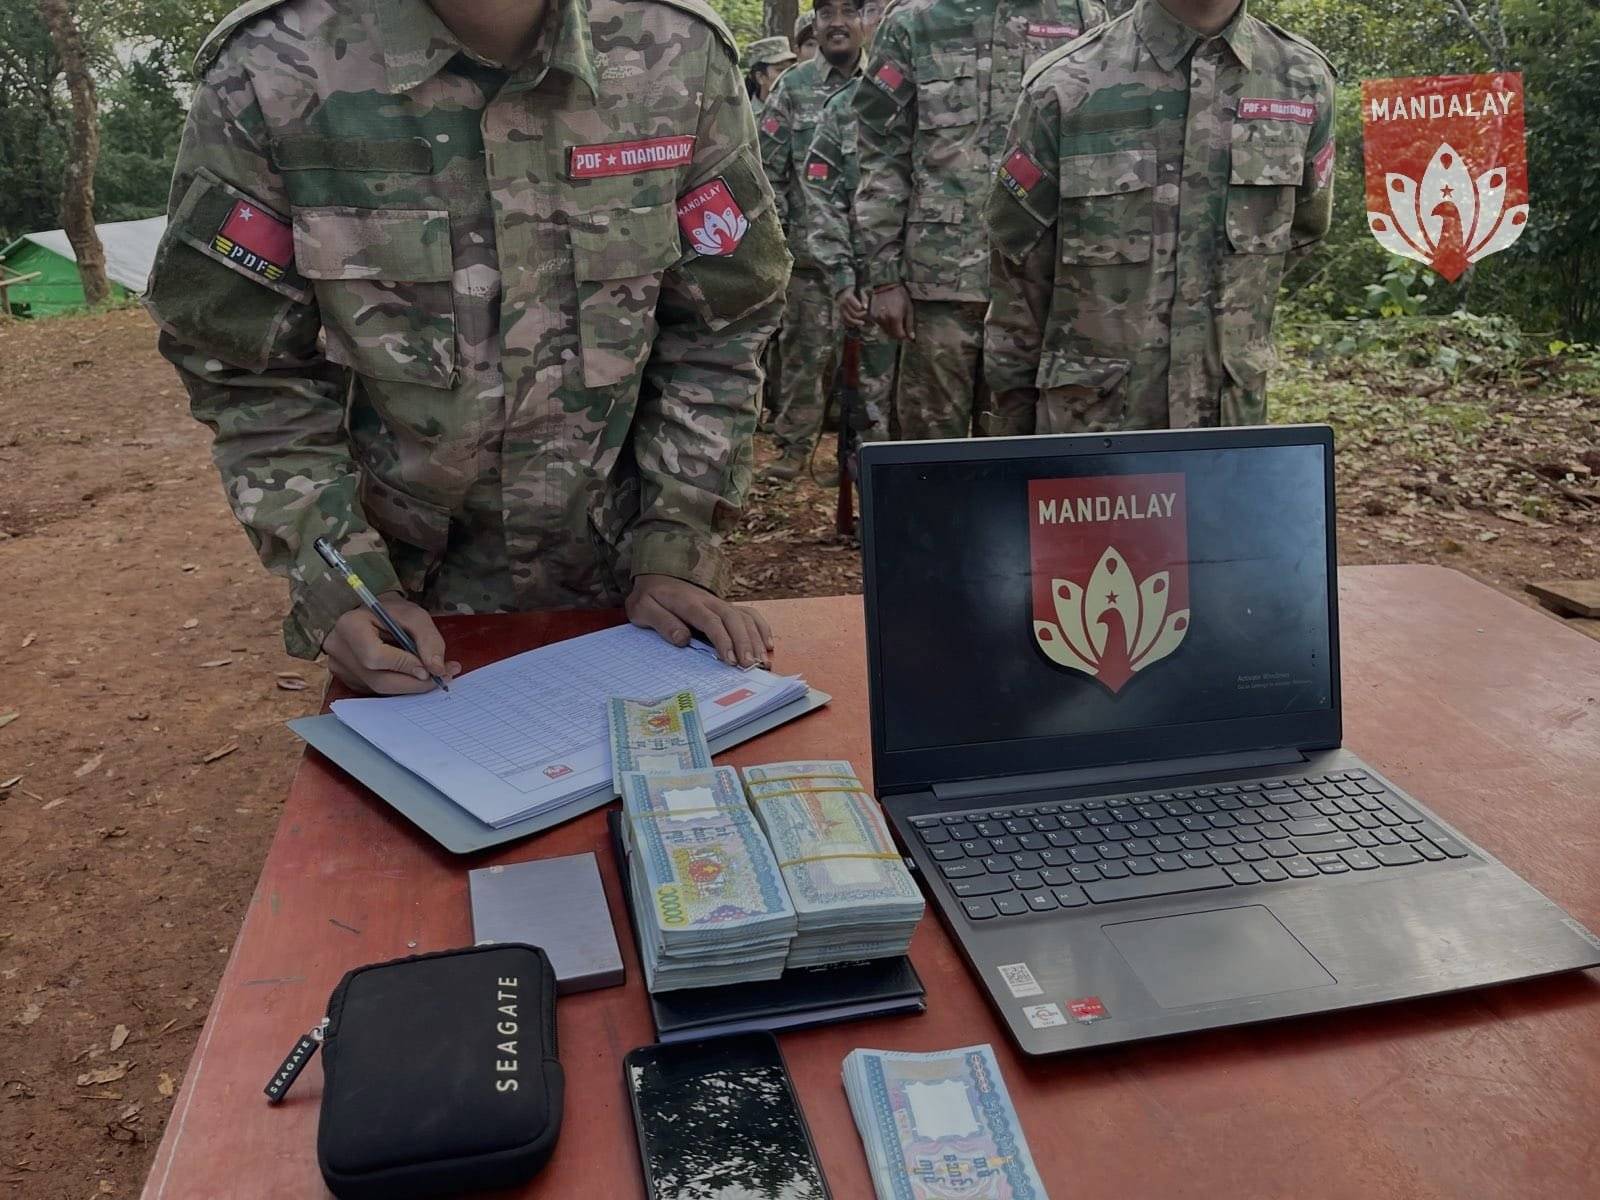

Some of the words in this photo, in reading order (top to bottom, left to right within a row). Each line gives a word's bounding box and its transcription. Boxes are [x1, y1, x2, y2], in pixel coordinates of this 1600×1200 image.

[576, 153, 603, 170] PDF
[677, 184, 721, 217] MANDALAY
[230, 245, 268, 272] PDF
[1038, 493, 1177, 525] MANDALAY
[496, 976, 519, 1091] SEAGATE
[270, 1041, 310, 1094] SEAGATE
